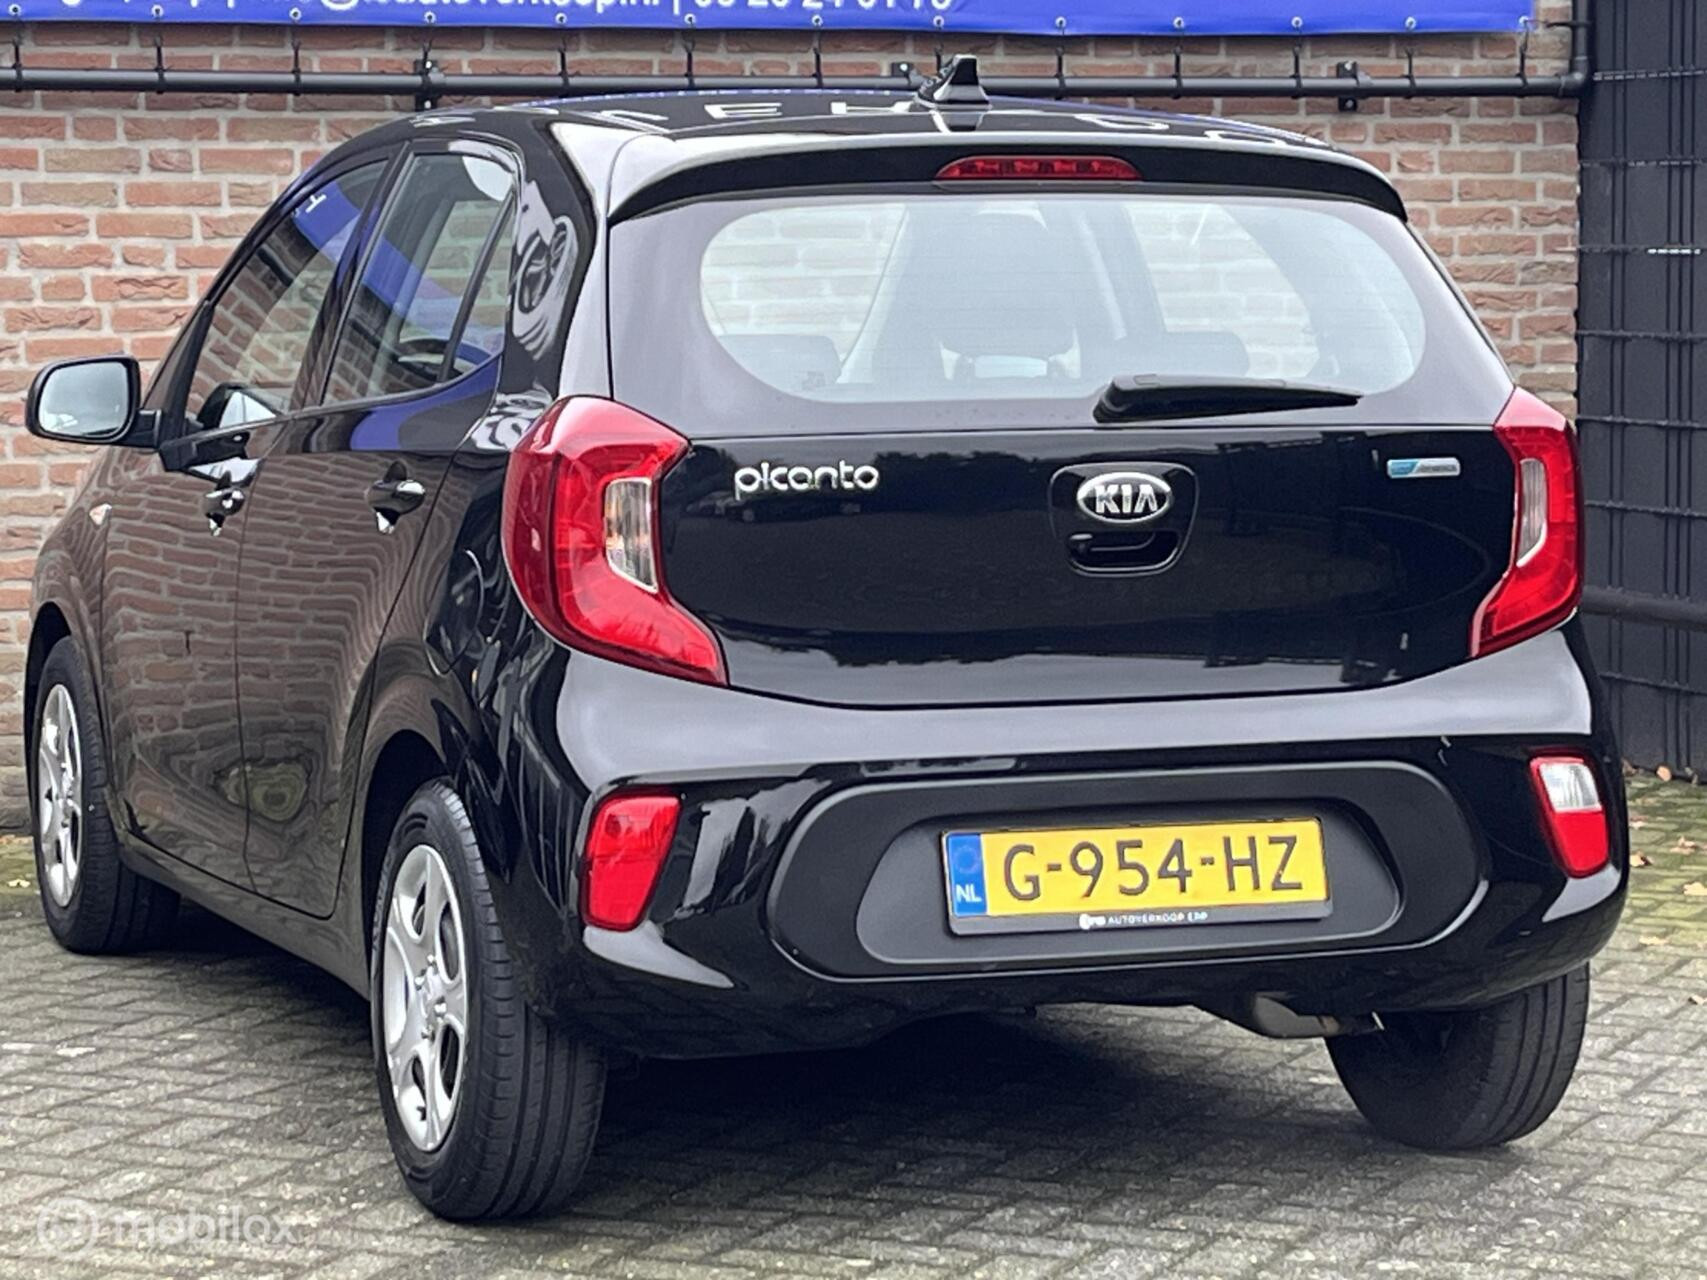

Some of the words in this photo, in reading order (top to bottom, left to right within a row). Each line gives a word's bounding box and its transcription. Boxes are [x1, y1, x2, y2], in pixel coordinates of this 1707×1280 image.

[734, 460, 879, 500] picanto
[1095, 484, 1158, 513] KIA
[1004, 835, 1303, 900] G-954-HZ
[955, 883, 982, 902] NL
